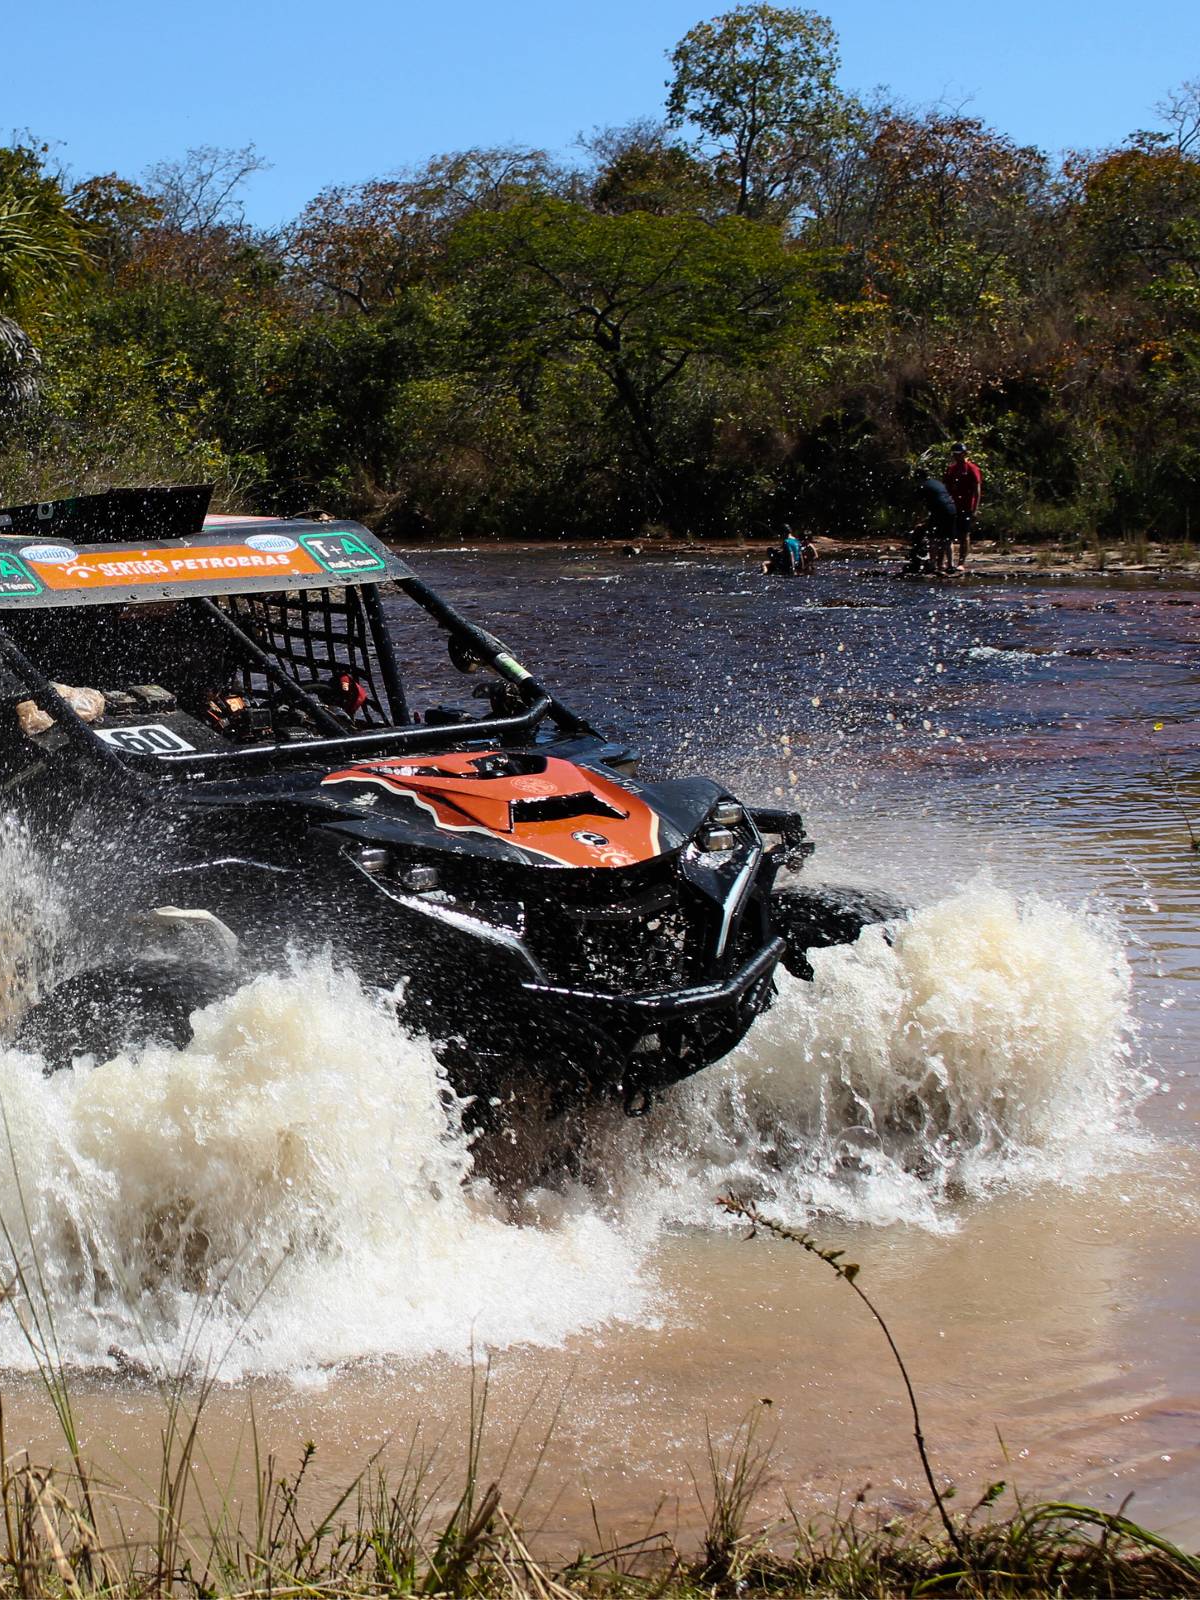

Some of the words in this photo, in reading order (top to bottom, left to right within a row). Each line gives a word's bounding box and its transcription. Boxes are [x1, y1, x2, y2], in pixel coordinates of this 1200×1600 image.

[254, 537, 292, 549] podium
[28, 548, 73, 560] podium
[170, 554, 291, 571] PETROBRAS
[3, 581, 35, 590] Team
[110, 729, 183, 753] 60
